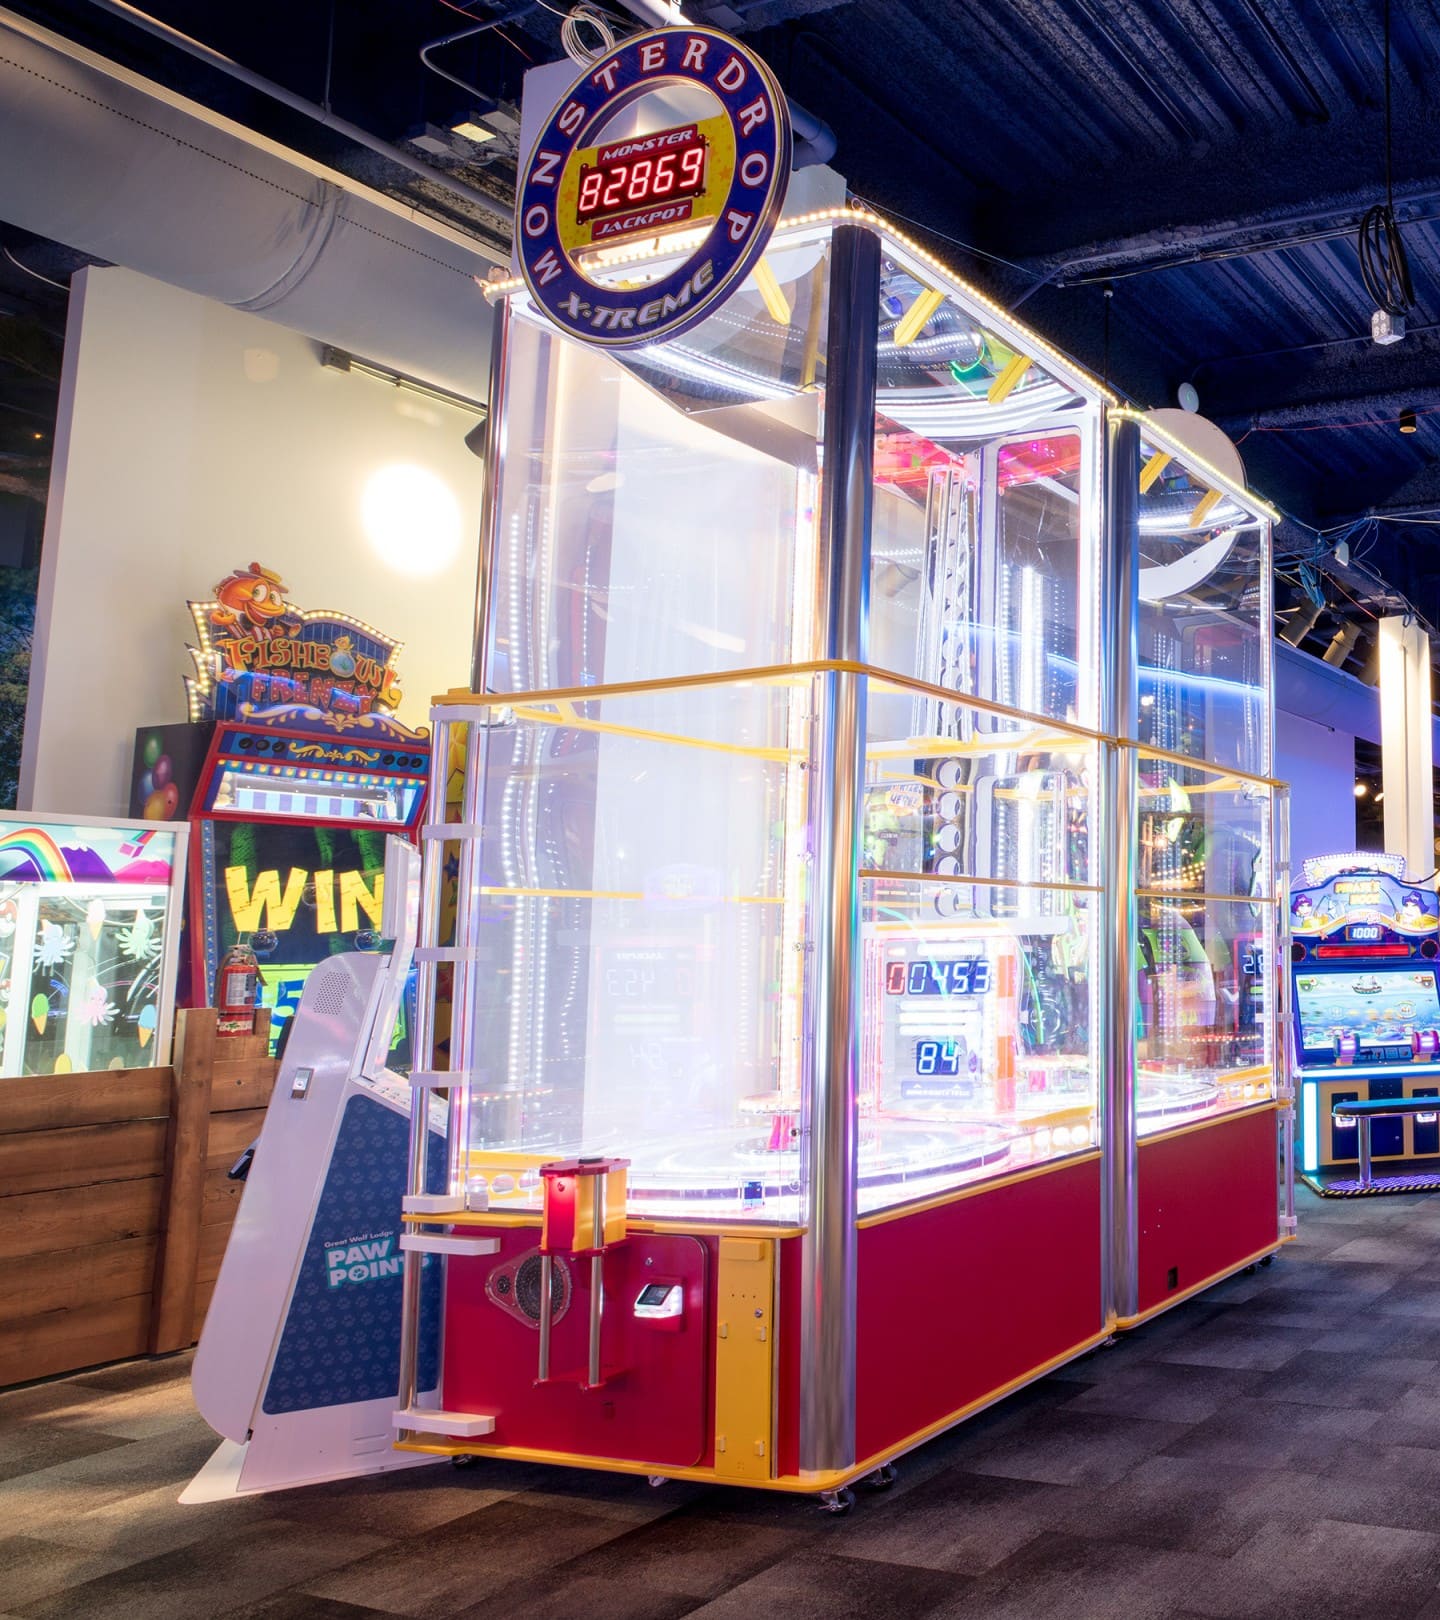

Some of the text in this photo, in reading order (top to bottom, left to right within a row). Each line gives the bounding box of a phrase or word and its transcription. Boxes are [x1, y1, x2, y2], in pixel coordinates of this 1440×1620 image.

[602, 129, 693, 161] MONSTER
[579, 148, 703, 211] 82869
[595, 204, 689, 236] JACKPOT
[251, 668, 378, 715] FRENZY
[224, 865, 384, 933] WIN
[1352, 927, 1378, 939] 1000
[918, 1043, 960, 1074] 84
[324, 1230, 394, 1249] Great Wolf Lodge
[327, 1239, 391, 1269] PAW
